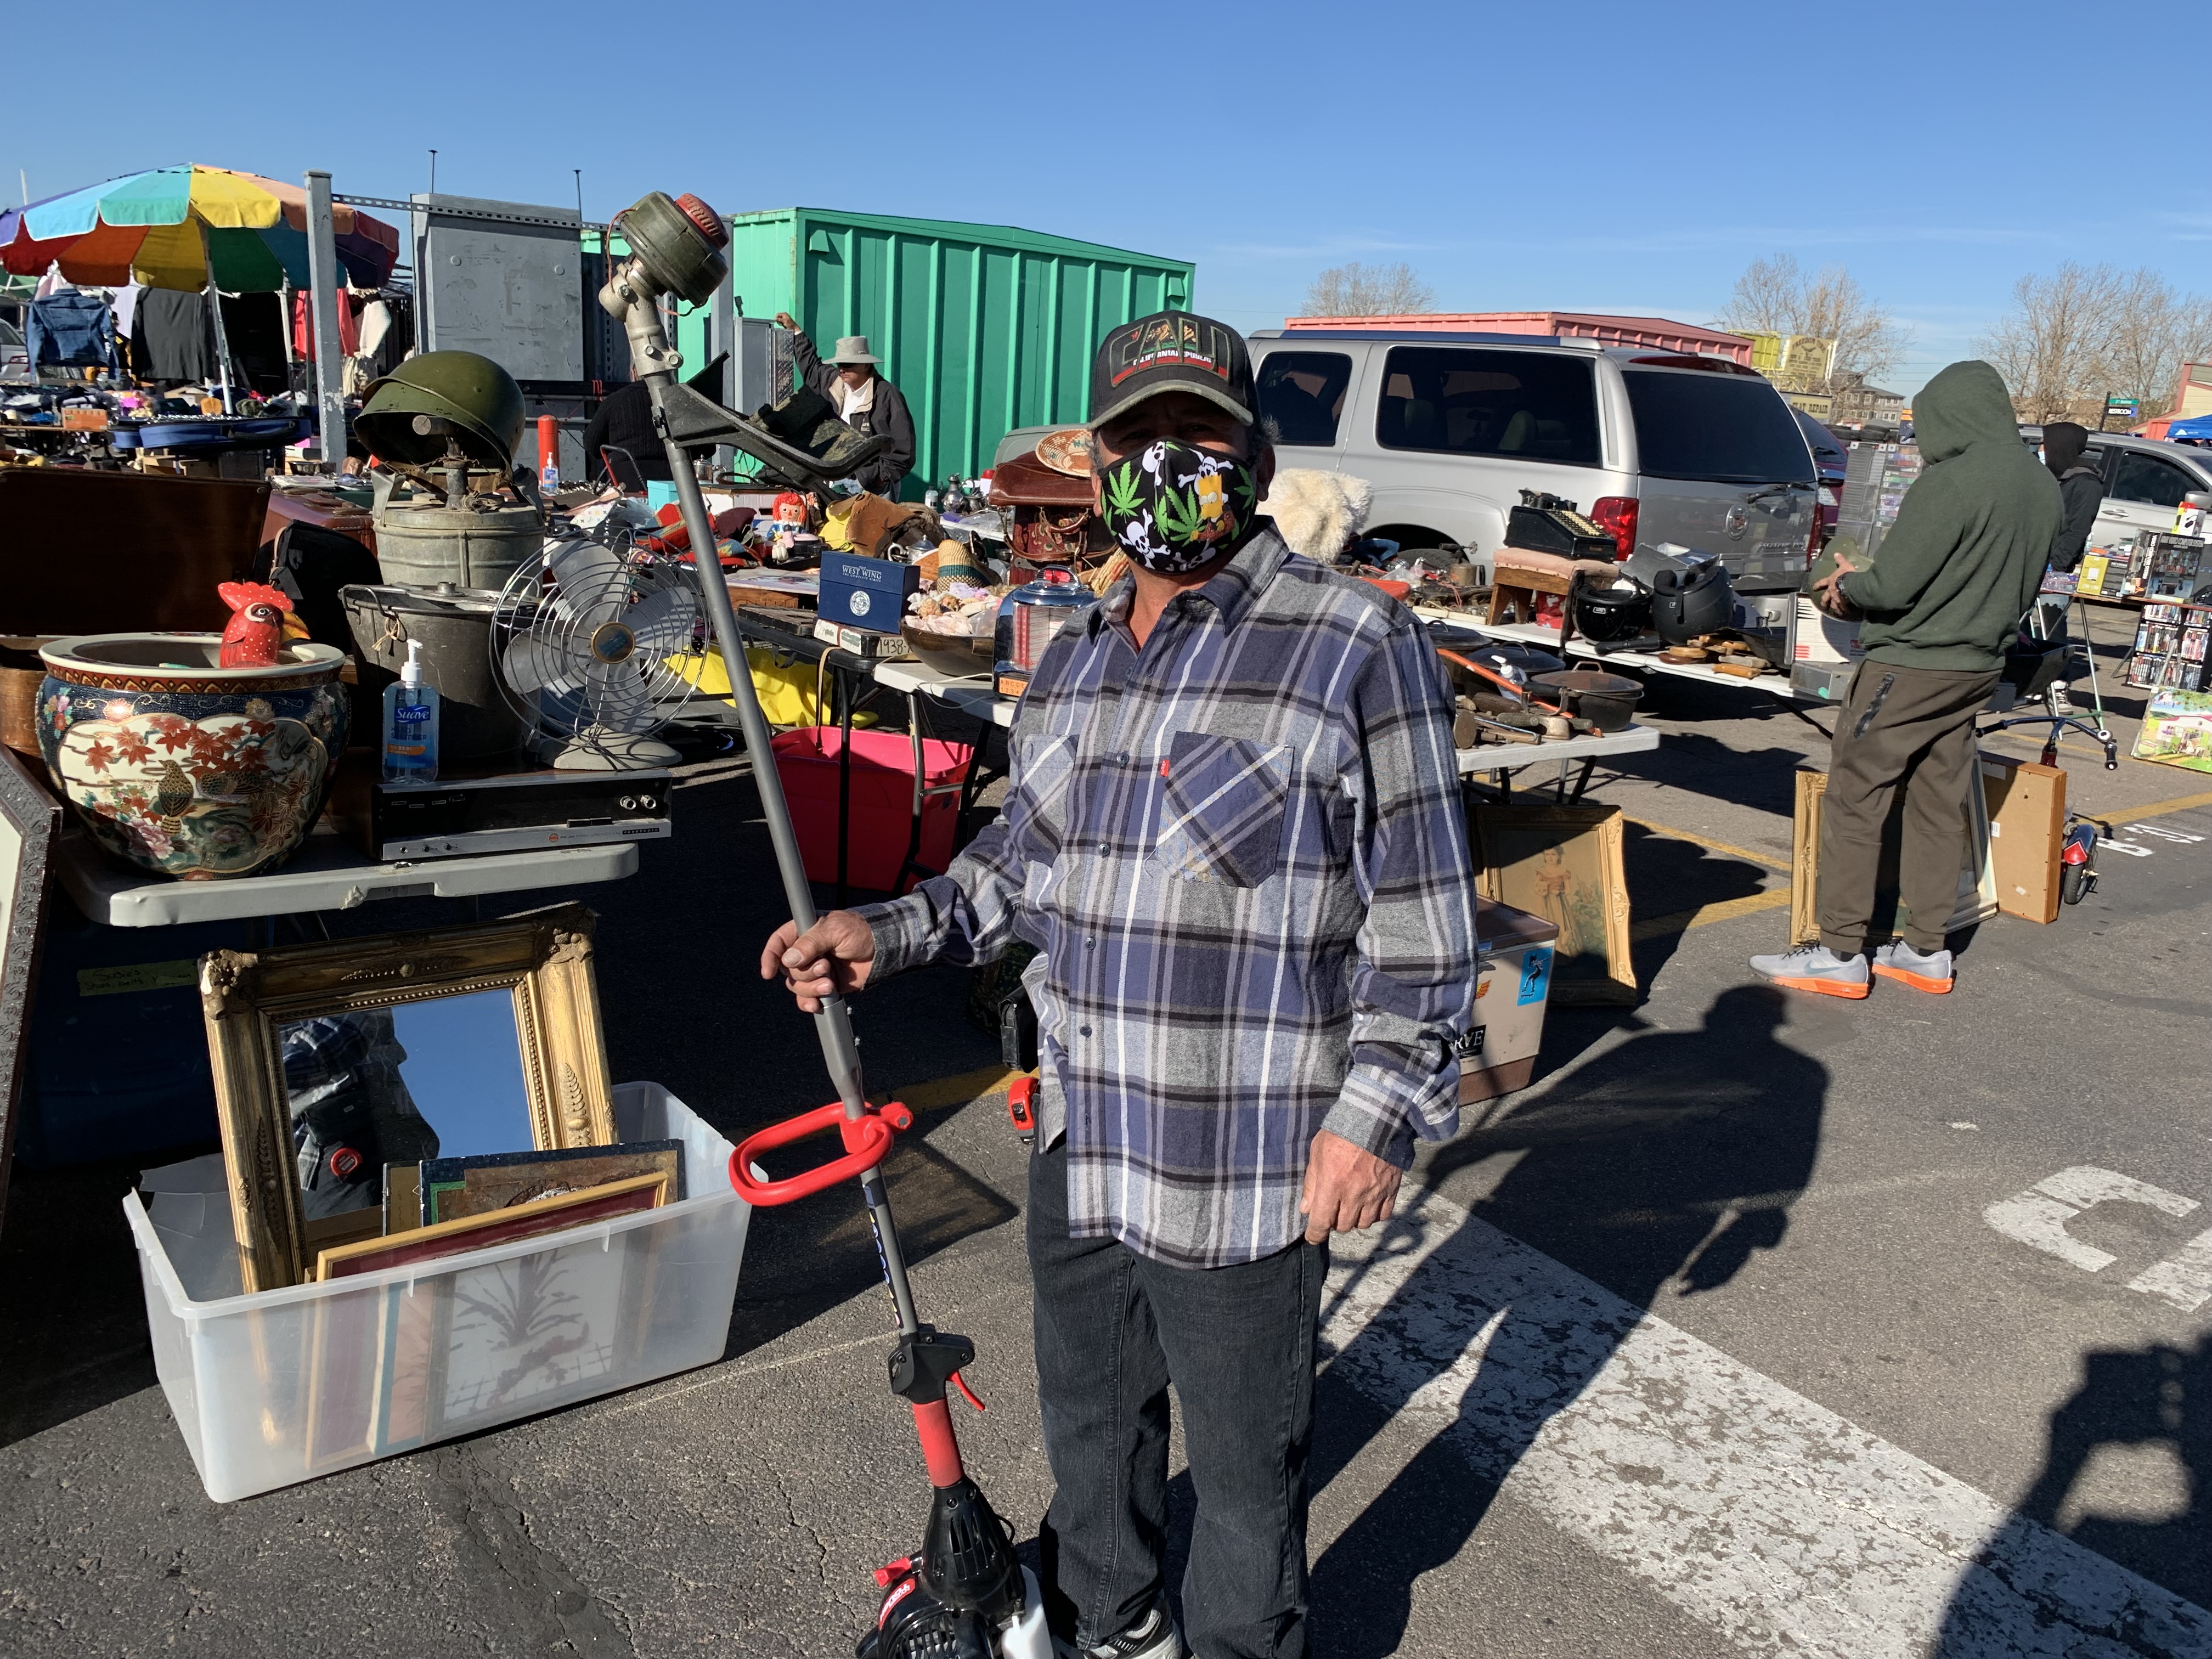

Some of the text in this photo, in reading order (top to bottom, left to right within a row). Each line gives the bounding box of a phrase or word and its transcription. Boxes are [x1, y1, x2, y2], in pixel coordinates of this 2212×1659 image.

[1133, 349, 1177, 365] CALIFRNIA
[842, 566, 882, 580] WEST WING
[396, 708, 430, 719] Suave
[391, 725, 411, 734] HD
